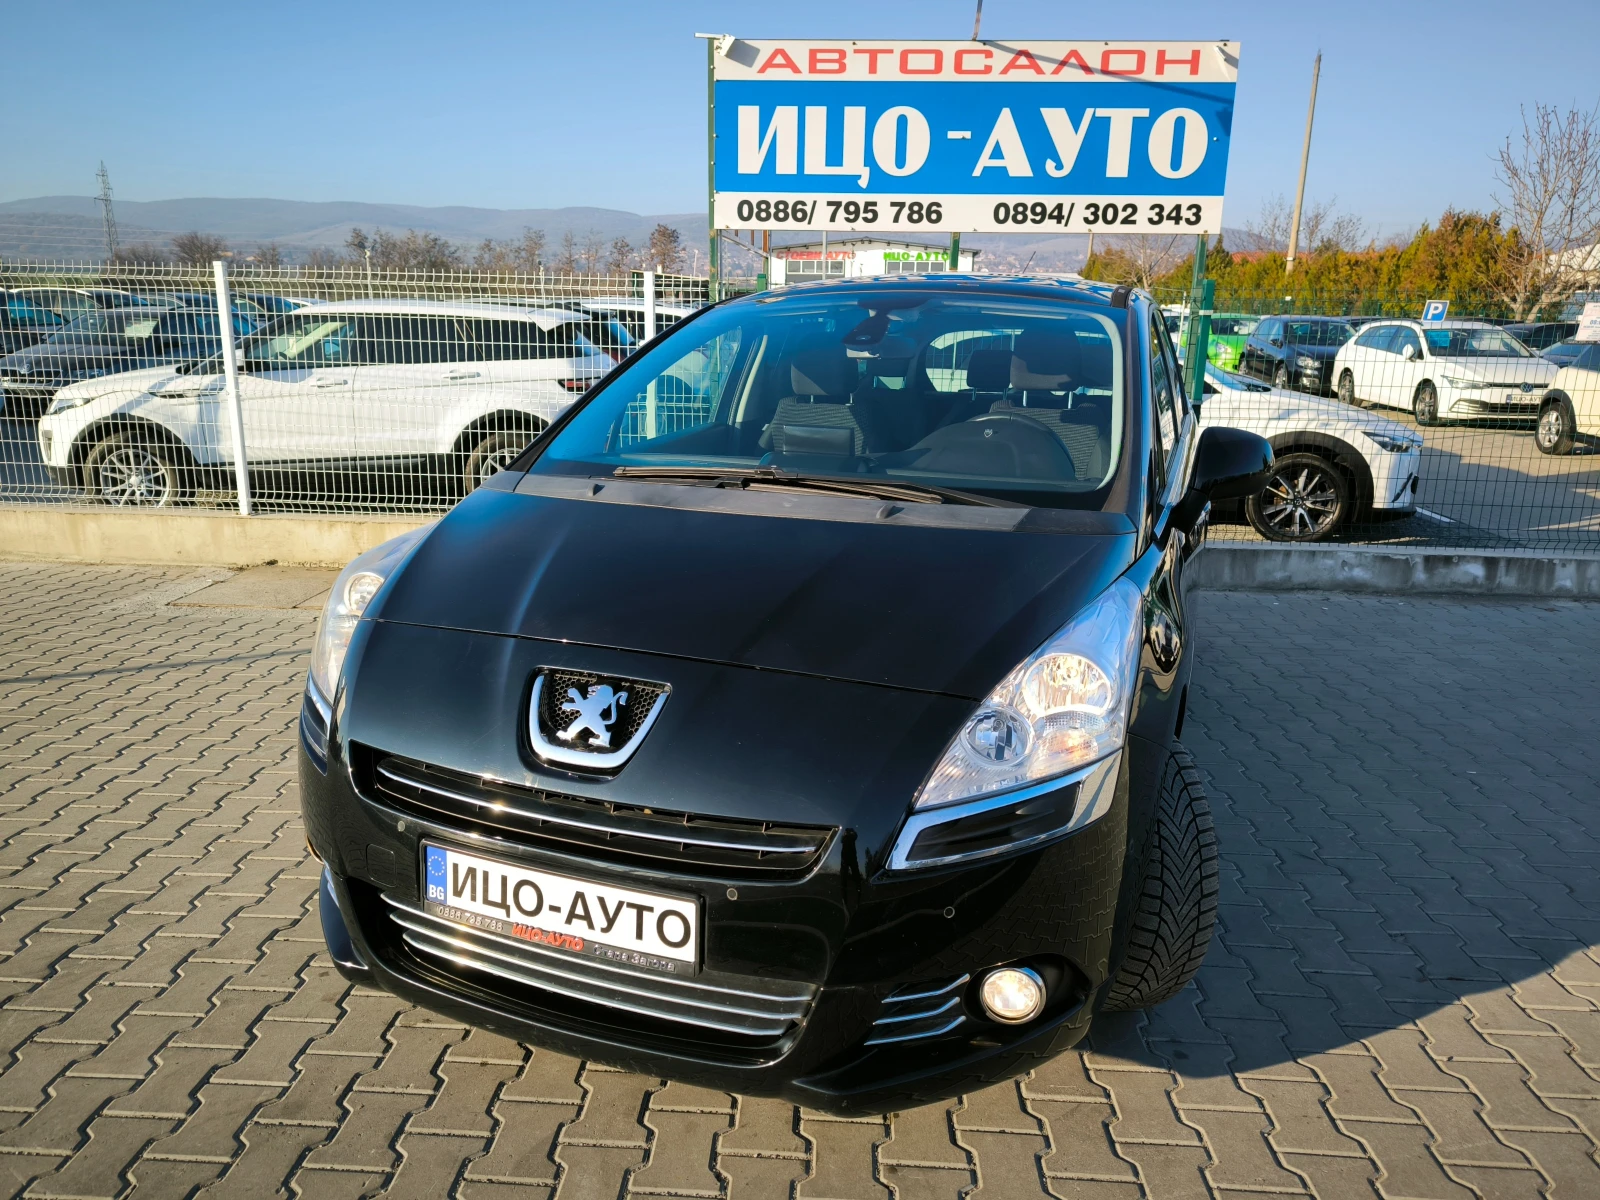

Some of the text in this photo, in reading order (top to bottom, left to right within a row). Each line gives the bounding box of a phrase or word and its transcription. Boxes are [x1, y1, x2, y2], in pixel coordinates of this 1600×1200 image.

[757, 47, 1202, 77] АВТОСАЛОН
[736, 199, 1203, 227] 0886/ 795 786 0894/ 302 343
[883, 251, 949, 261] ИЦО-АУТО
[1428, 303, 1442, 319] P
[428, 884, 445, 901] BG
[452, 862, 692, 949] ИЦО-АУТО
[511, 922, 585, 952] ИЦО-АУТО
